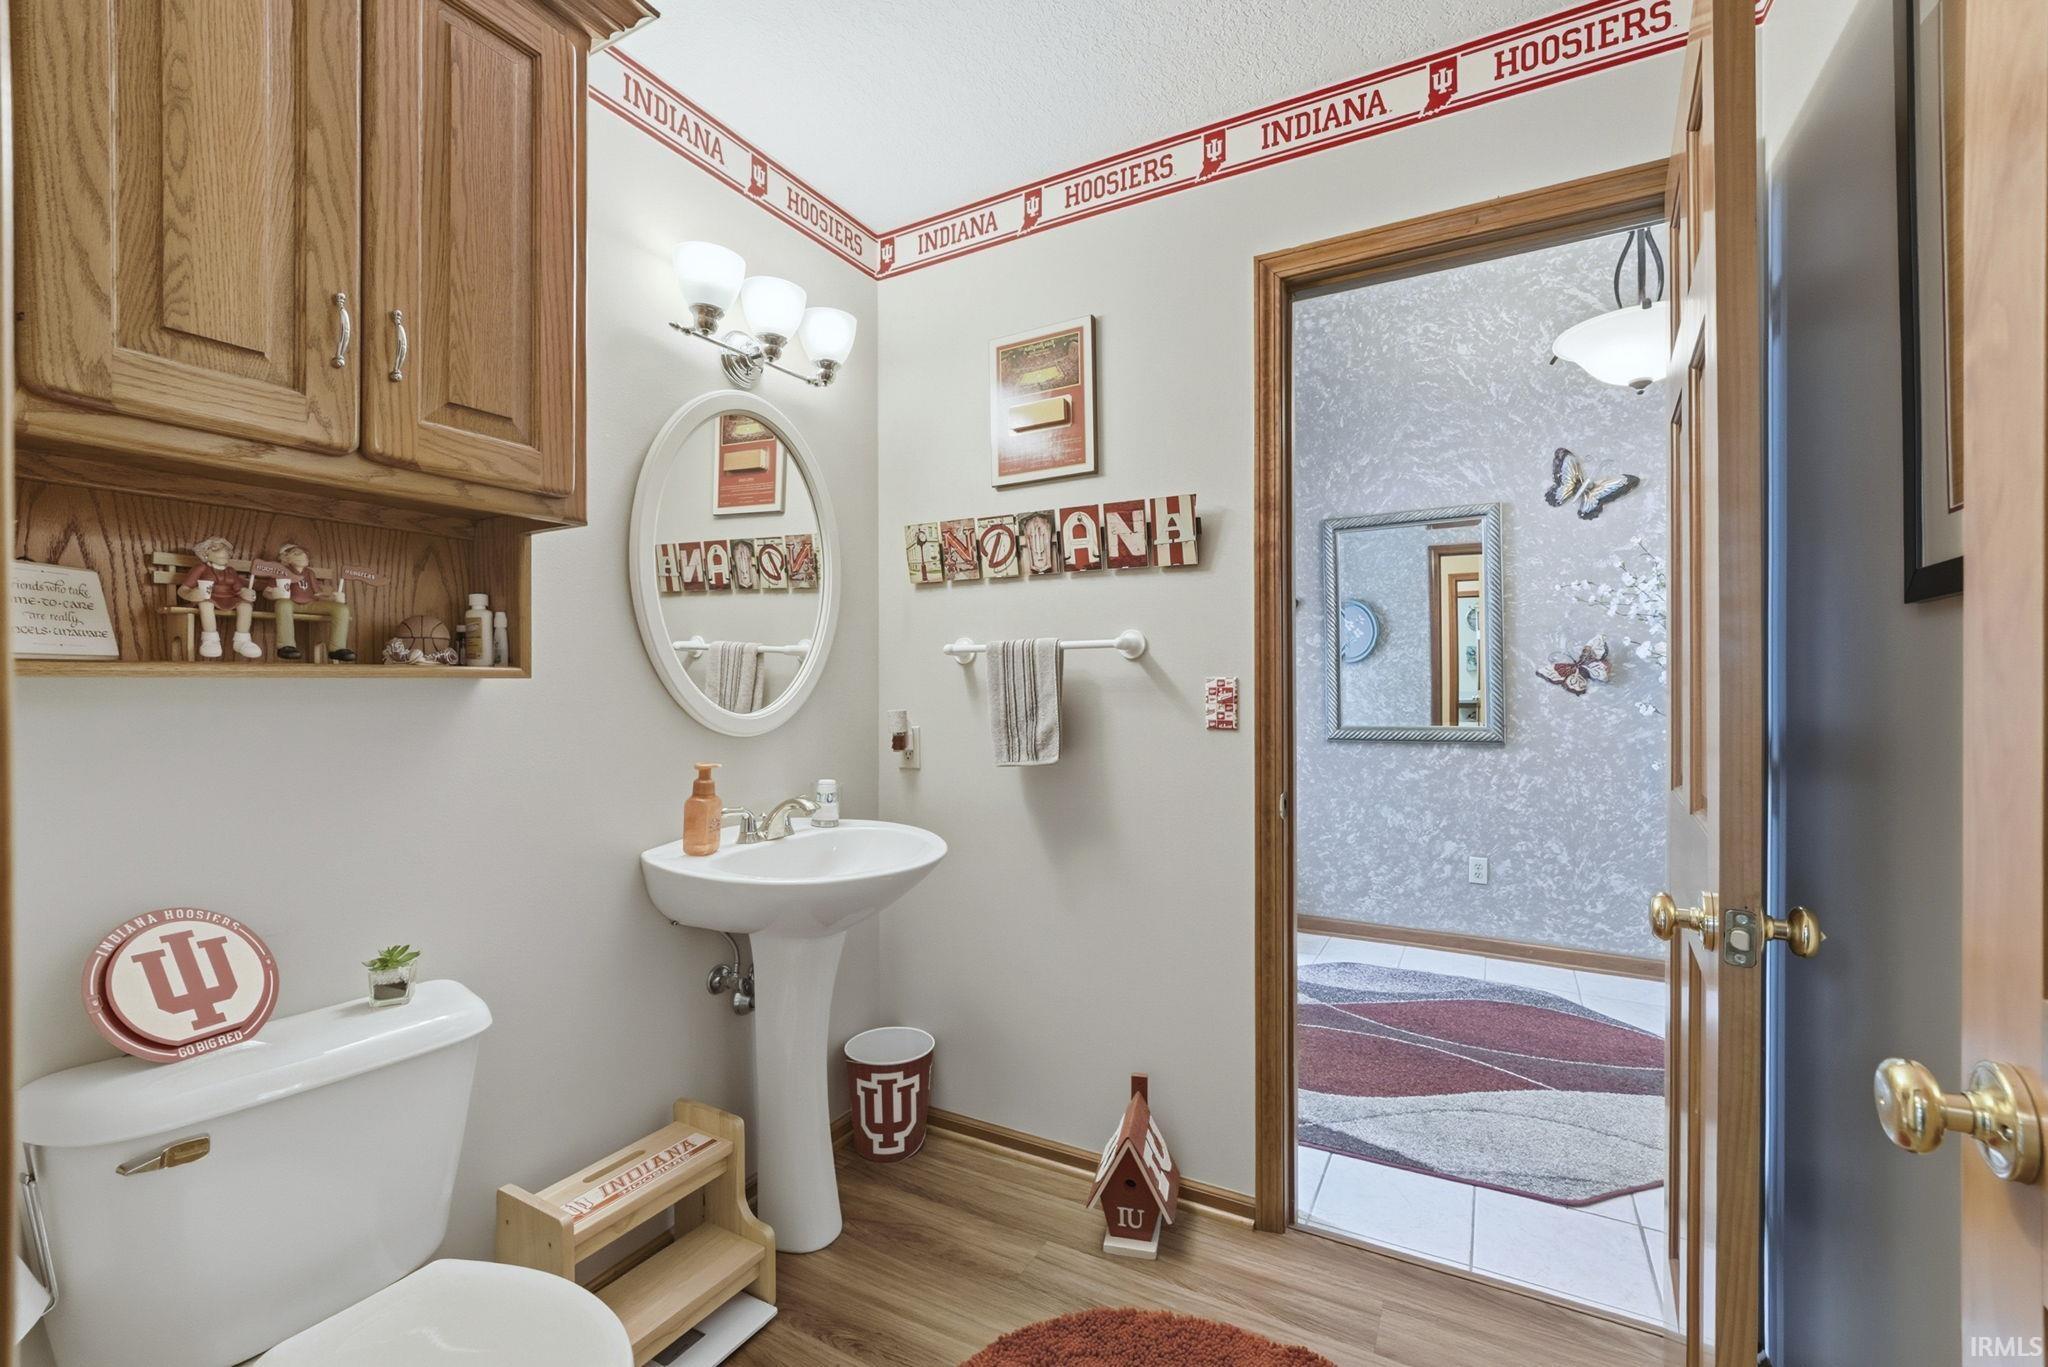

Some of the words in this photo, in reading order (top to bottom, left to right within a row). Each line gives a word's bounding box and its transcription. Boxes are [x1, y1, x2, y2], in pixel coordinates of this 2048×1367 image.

[1261, 89, 1388, 150] INDIANA
[1494, 0, 1672, 81] HOOSIERS
[623, 72, 725, 165] INDIANA
[786, 186, 863, 257] HOOSIERS
[918, 210, 998, 255] INDIANA
[1064, 153, 1174, 209] HOOSIERS
[68, 583, 91, 598] take
[50, 611, 85, 628] really
[96, 914, 158, 957] INDIANA
[164, 909, 241, 931] HOOSIERS
[178, 1045, 195, 1058] GO
[196, 1038, 217, 1052] BIG
[218, 1030, 243, 1046] RED
[599, 1139, 697, 1198] INDIANA
[1117, 1206, 1145, 1229] IU
